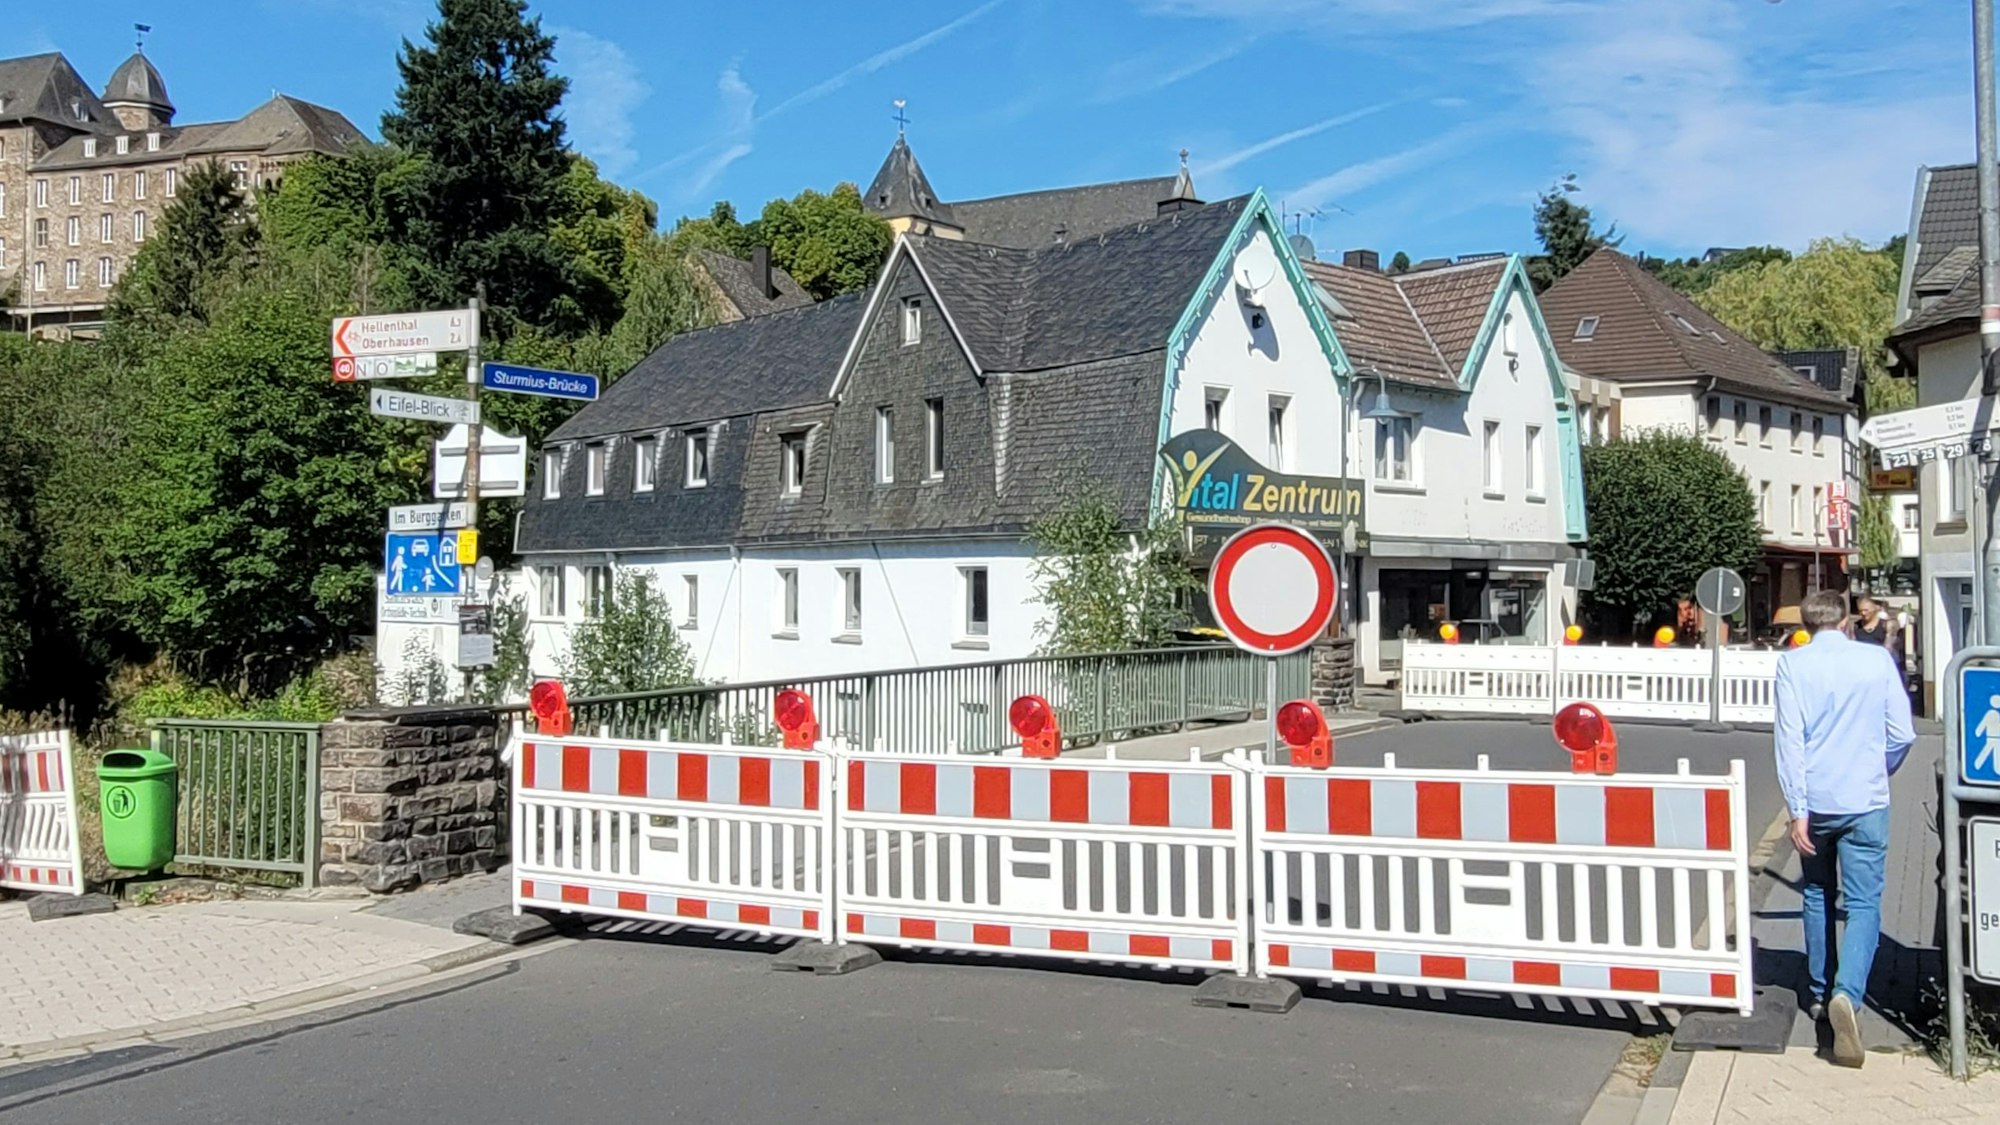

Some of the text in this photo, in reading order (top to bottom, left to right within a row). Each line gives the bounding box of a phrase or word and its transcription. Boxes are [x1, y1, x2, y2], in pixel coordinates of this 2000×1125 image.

[361, 319, 418, 333] Hellenthal
[362, 336, 429, 349] Oberhausen
[356, 363, 367, 377] N
[493, 371, 589, 395] Sturmius-Brücke
[388, 395, 450, 418] Eifel-Blick
[1921, 449, 1935, 460] 25
[1946, 444, 1964, 459] 29
[1892, 453, 1910, 468] 23
[1242, 474, 1362, 516] Zentrum
[394, 511, 406, 524] Im
[1980, 912, 2000, 931] ge
